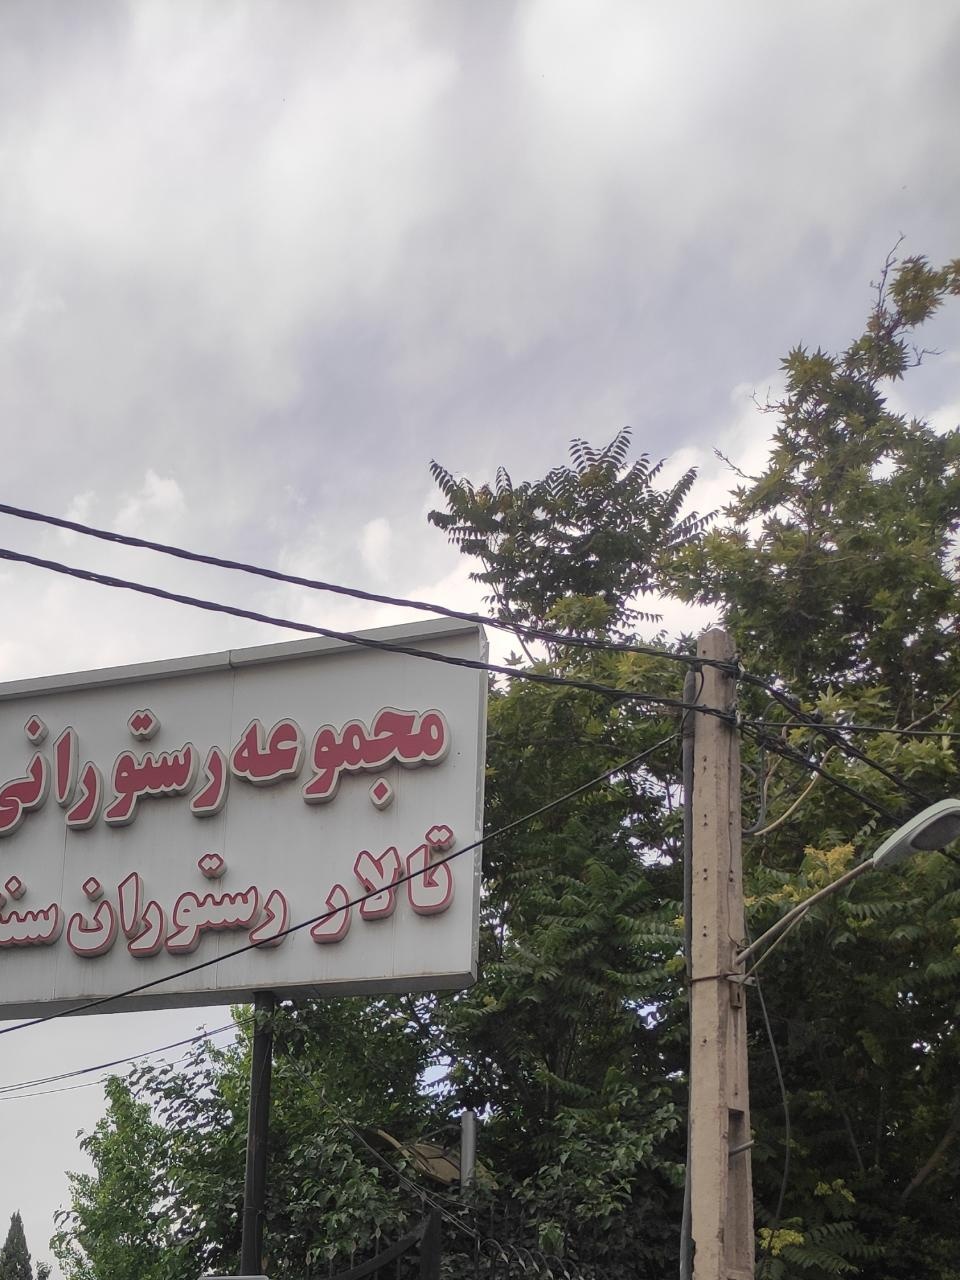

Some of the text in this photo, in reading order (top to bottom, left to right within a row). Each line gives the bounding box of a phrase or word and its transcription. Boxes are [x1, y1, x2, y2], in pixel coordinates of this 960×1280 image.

[232, 707, 451, 809] مجموعه
[67, 853, 290, 957] رستوران
[311, 825, 455, 943] تالار
